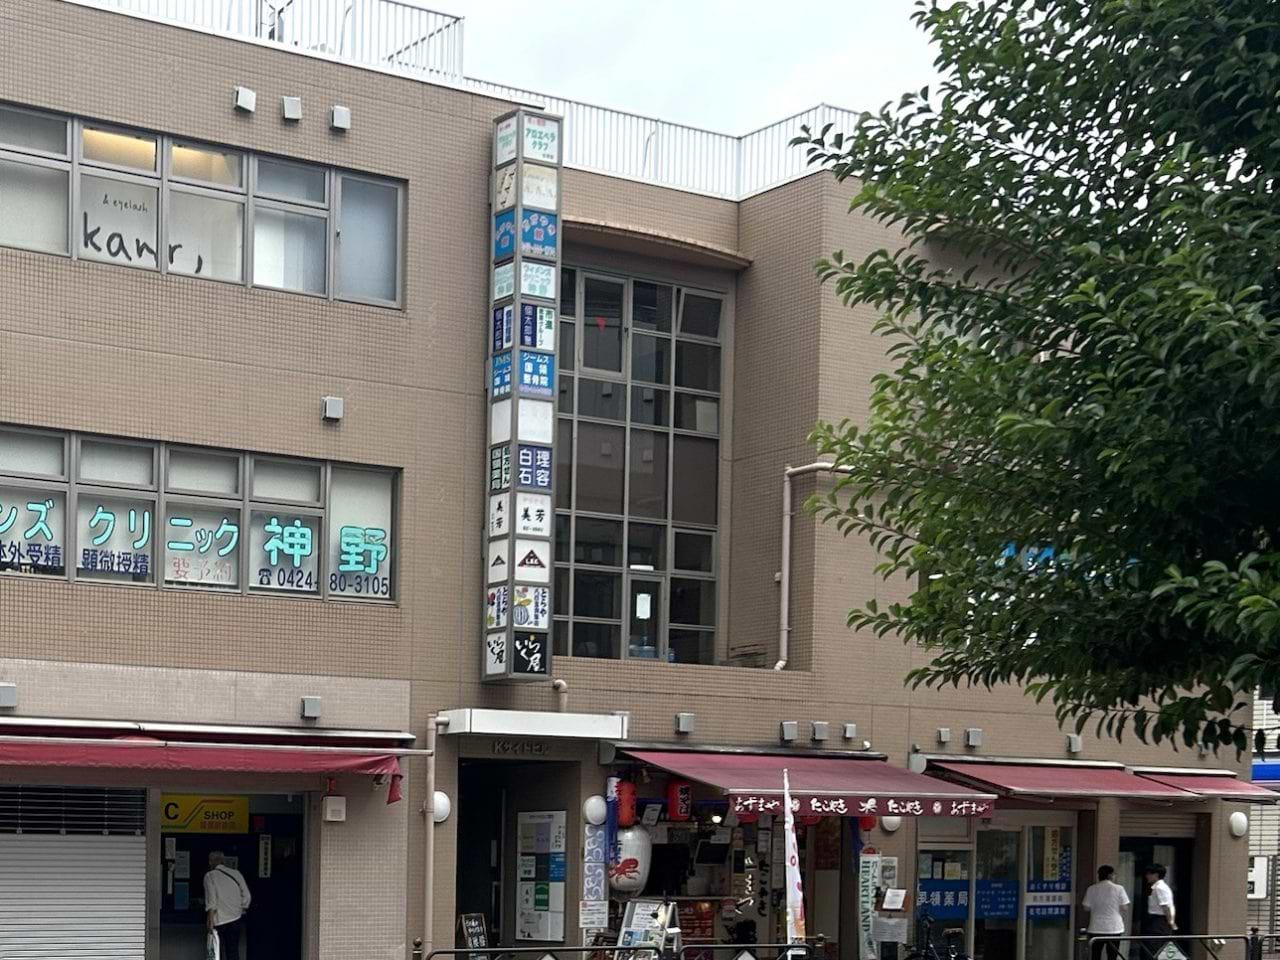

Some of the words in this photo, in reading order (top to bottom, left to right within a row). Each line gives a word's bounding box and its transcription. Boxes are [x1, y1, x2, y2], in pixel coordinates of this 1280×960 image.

[113, 199, 148, 214] eyelash
[519, 448, 532, 485] 白石
[536, 450, 550, 487] 理容
[164, 802, 179, 820] C
[203, 810, 235, 821] SHOP
